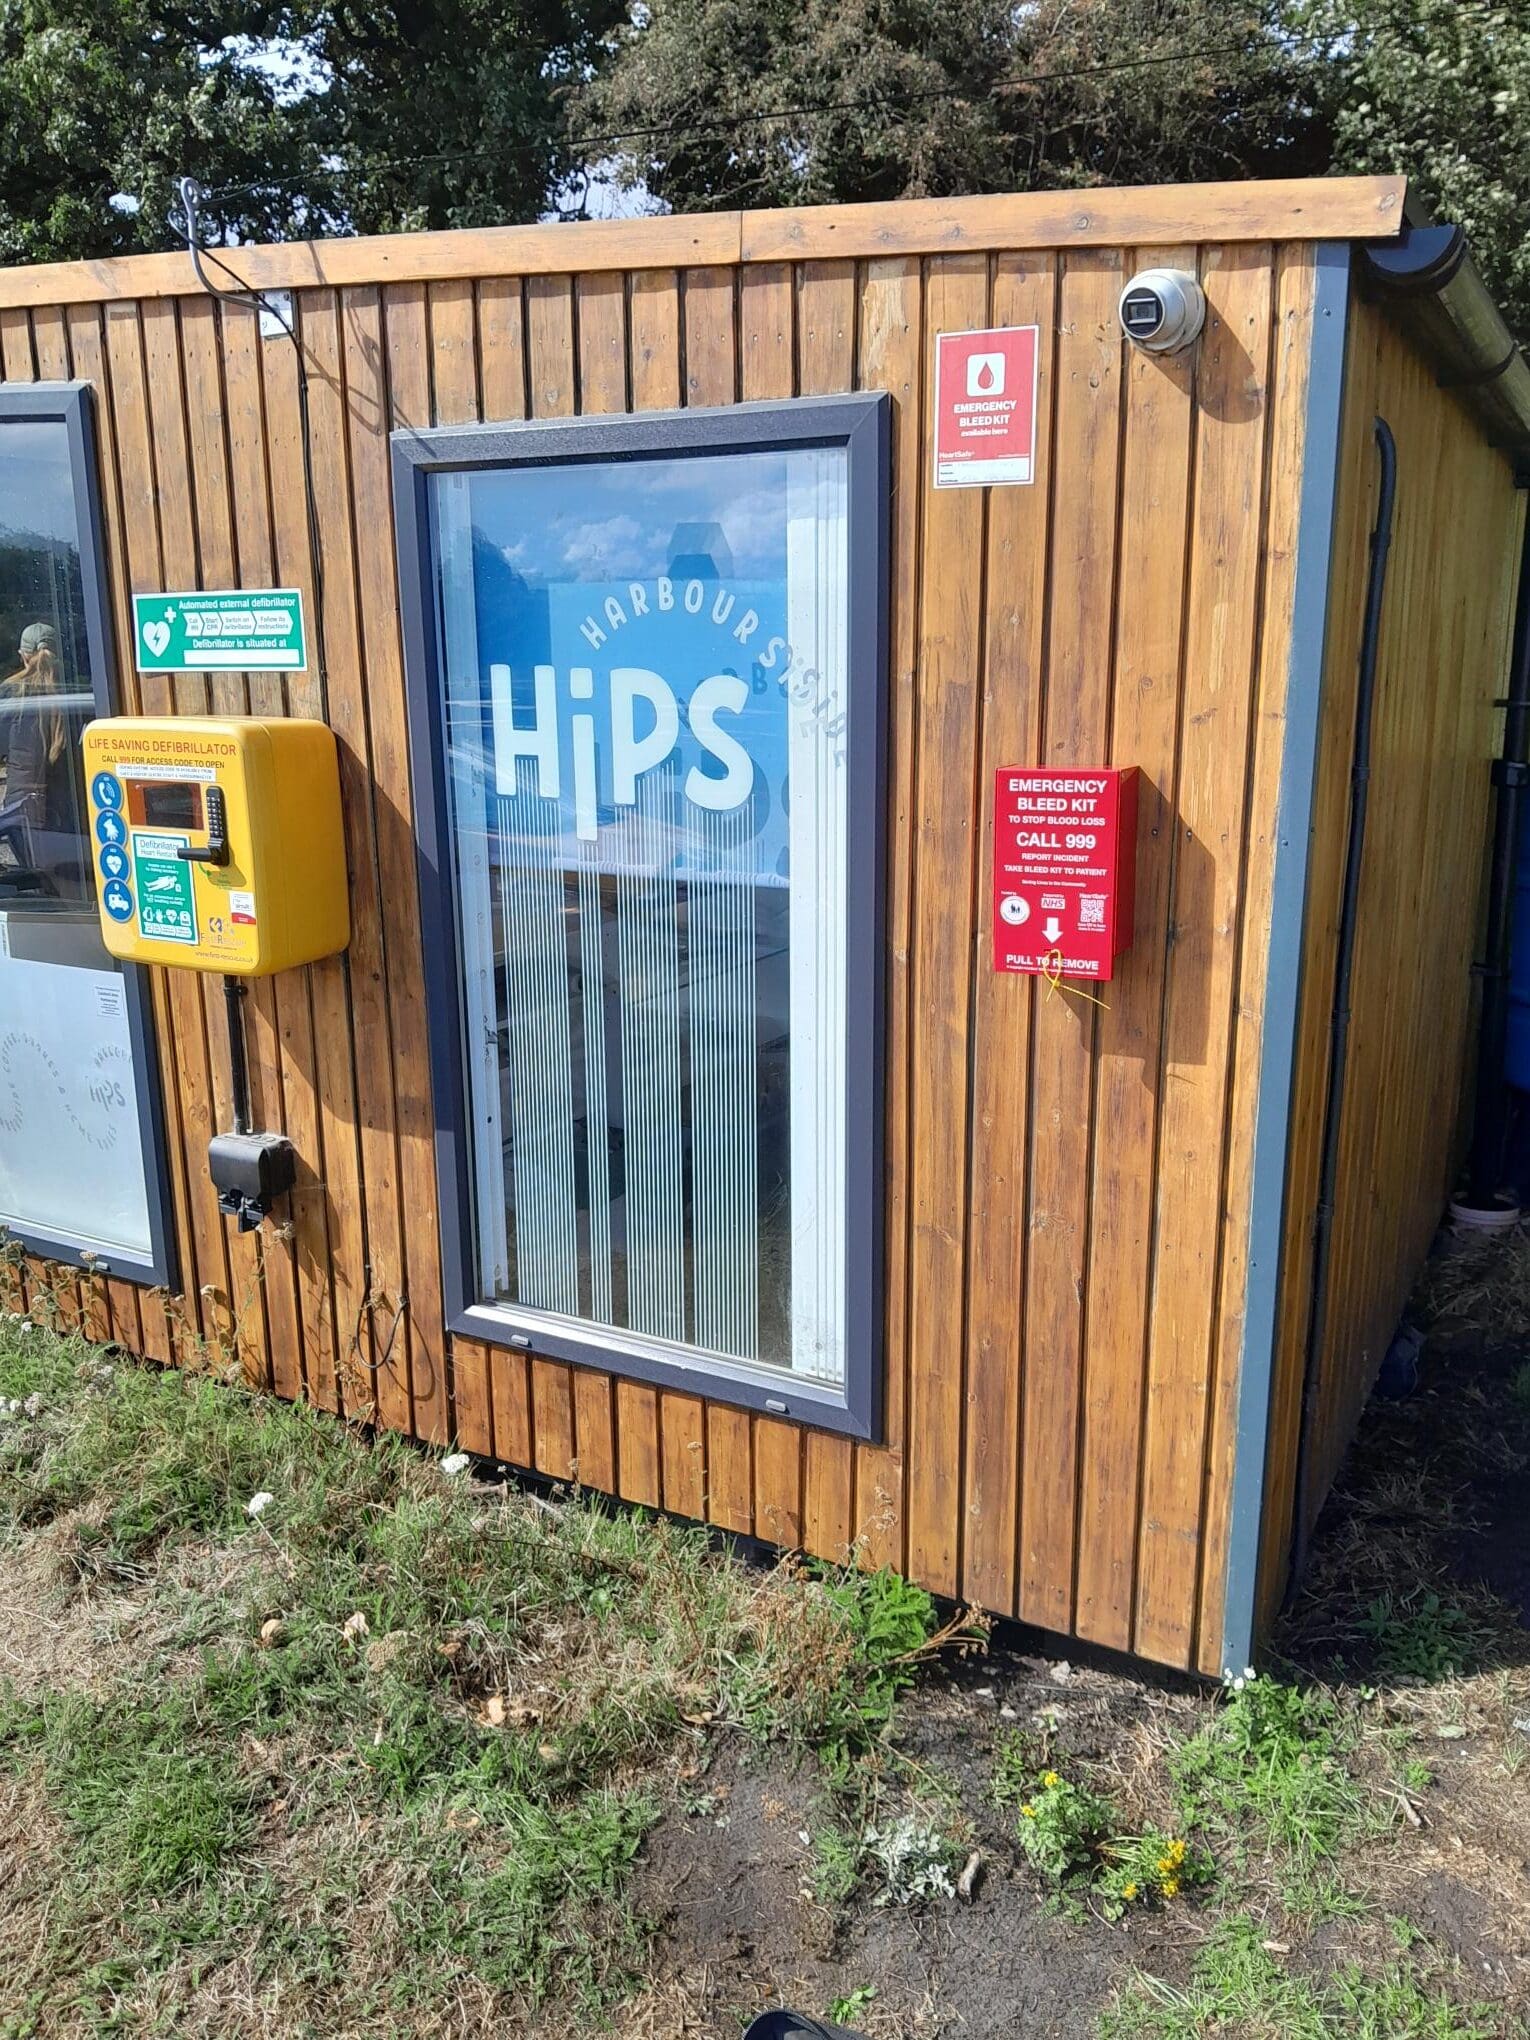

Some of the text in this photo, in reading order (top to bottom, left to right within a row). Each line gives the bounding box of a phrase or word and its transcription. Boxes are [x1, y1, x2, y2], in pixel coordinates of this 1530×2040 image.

[953, 400, 1017, 414] EMERGENCY
[959, 414, 1010, 427] BLEED KIT
[961, 428, 991, 437] available
[179, 598, 295, 610] Automated external defibrillator
[193, 638, 286, 648] Defibrillator is situated at
[88, 738, 237, 756] LIFE SAVING DEFIBRILLATOR
[102, 755, 118, 763] CALL
[131, 756, 145, 765] FOR
[146, 757, 172, 766] ACCESS
[173, 759, 194, 767] CODE
[194, 760, 204, 768] TO
[205, 760, 225, 769] OPEN
[1008, 778, 1108, 793] EMERGENCY
[1017, 797, 1097, 812] BLEED KIT
[1008, 815, 1106, 826] TO STOP BLOOD LOSS
[1016, 831, 1096, 849] CALL 999
[1021, 853, 1090, 863] REPORT INCIDENT
[1004, 865, 1107, 876] TAKE BLEED KIT TO PATIENT
[1042, 899, 1064, 908] NHS
[1006, 954, 1034, 965] PULL
[1036, 956, 1050, 966] TO
[1053, 958, 1099, 970] REMOVE
